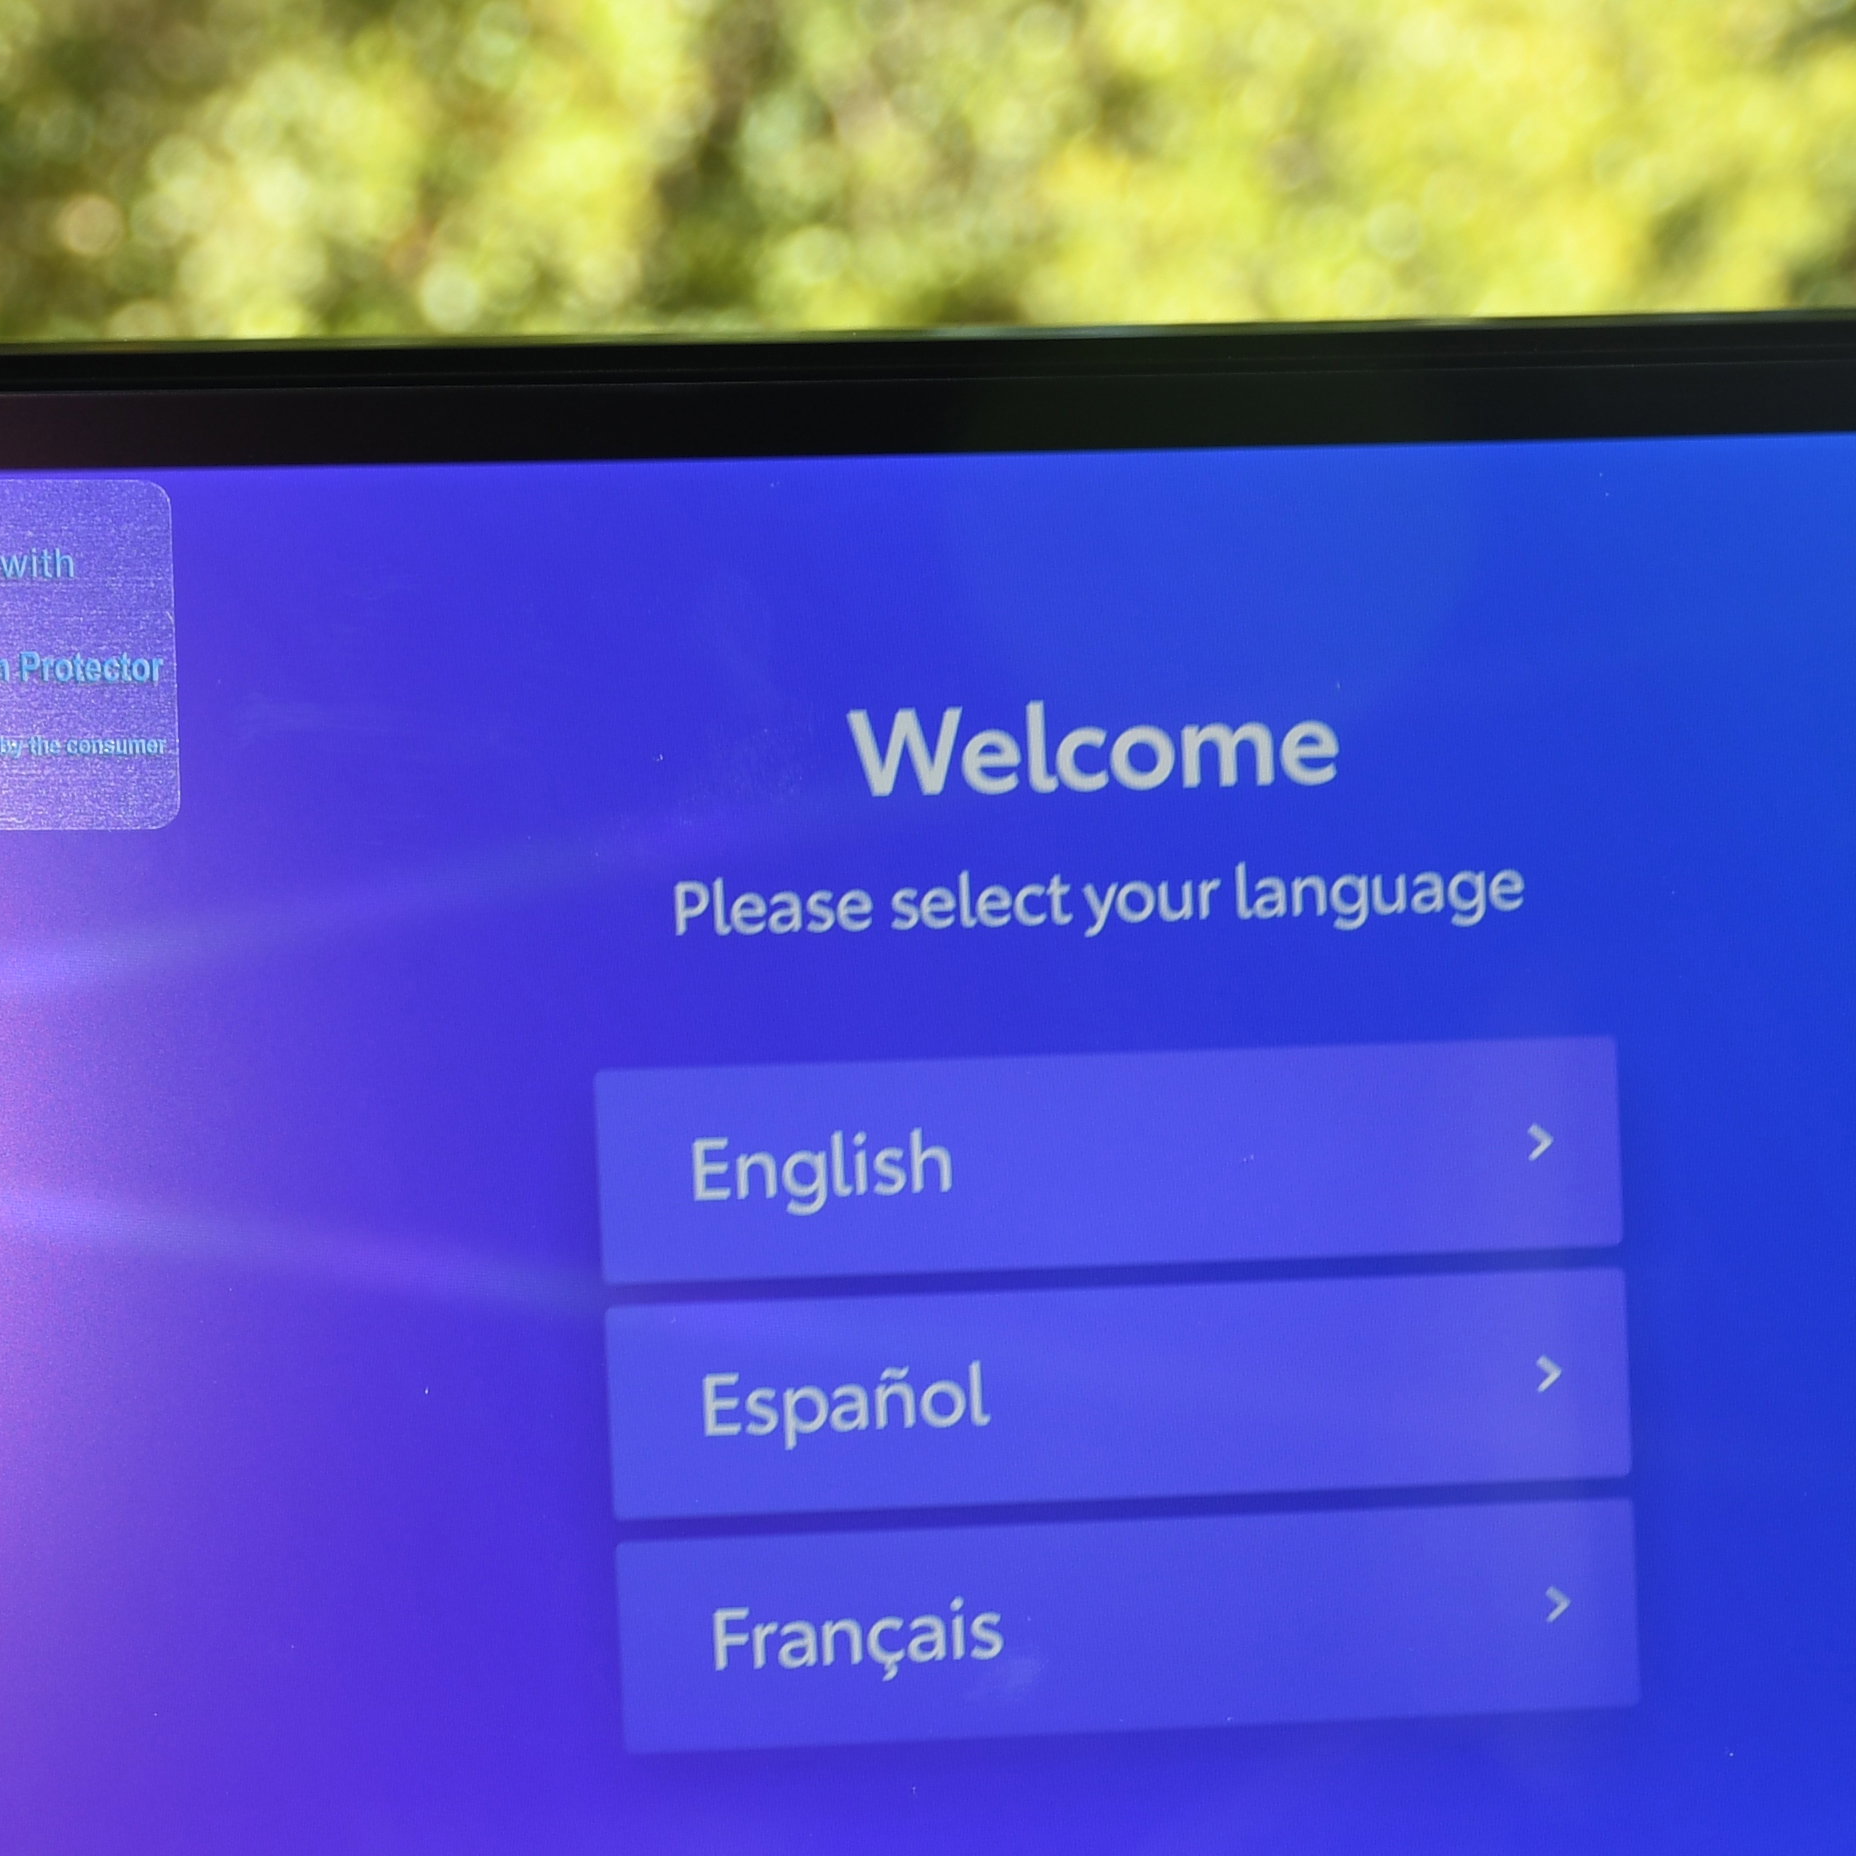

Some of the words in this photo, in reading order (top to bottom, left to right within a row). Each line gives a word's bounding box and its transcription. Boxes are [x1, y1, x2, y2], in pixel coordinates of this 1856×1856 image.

[0, 548, 76, 579] with
[21, 650, 164, 684] Protector
[28, 736, 61, 756] the
[65, 738, 167, 756] consumer
[848, 701, 1341, 798] Welcome
[673, 878, 873, 937] Please
[891, 871, 1072, 931] select
[1083, 872, 1220, 936] your
[1235, 862, 1526, 928] language
[690, 1129, 954, 1216] English
[701, 1361, 992, 1449] Español
[712, 1598, 1005, 1681] Français
